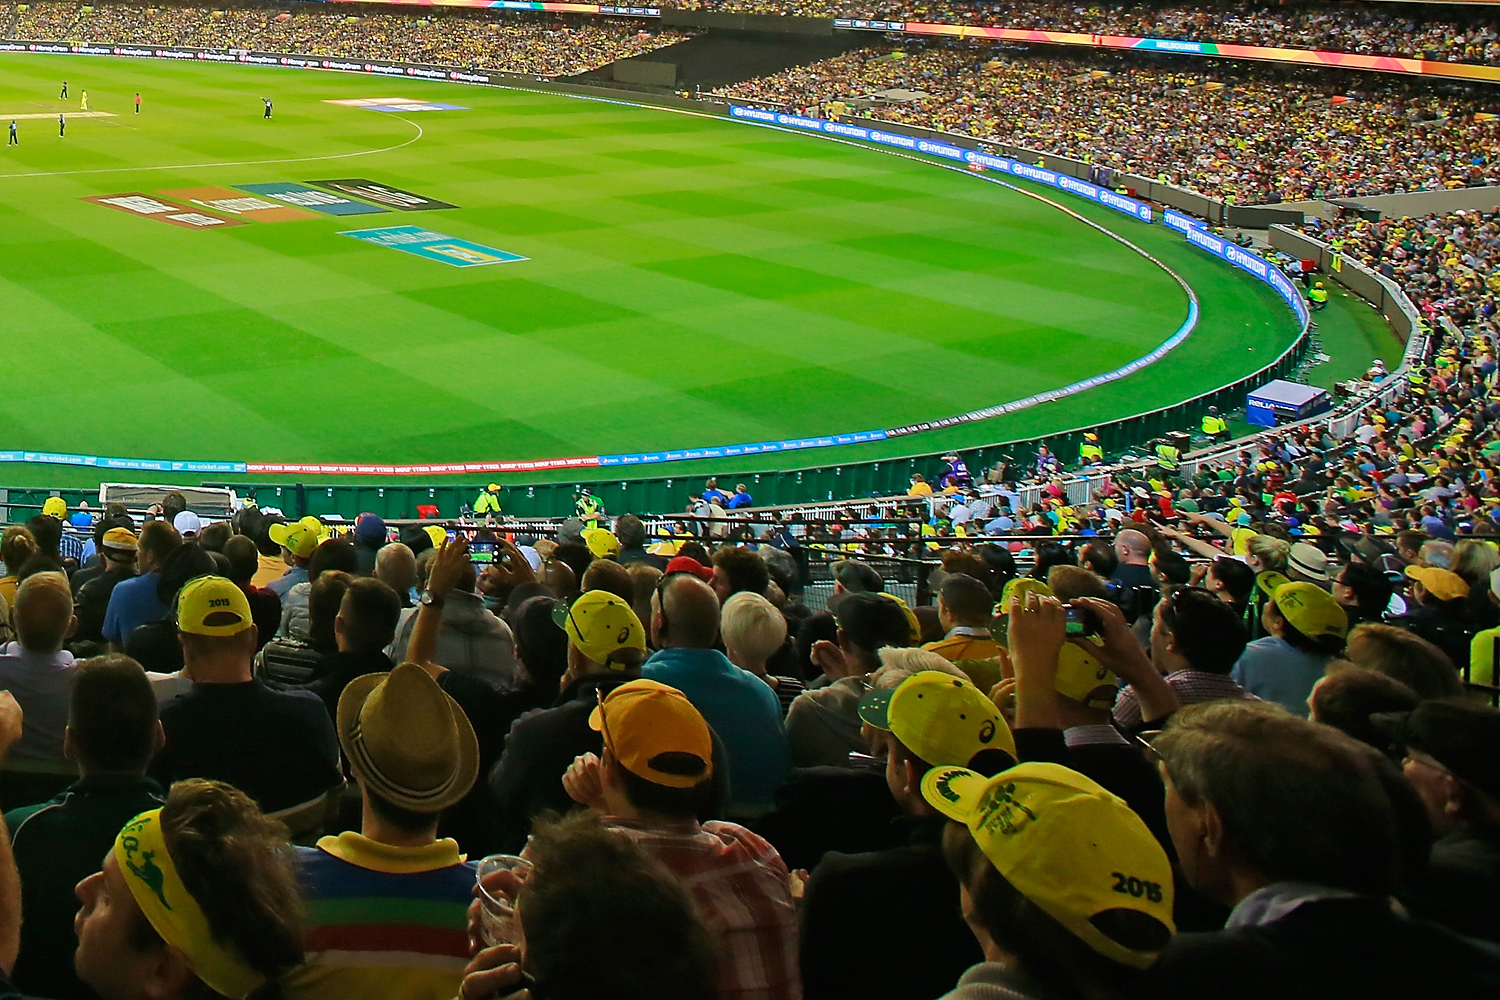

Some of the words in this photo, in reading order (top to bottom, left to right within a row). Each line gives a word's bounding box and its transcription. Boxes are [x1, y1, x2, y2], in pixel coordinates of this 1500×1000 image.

[1156, 41, 1200, 50] MELBOURNE
[120, 48, 151, 56] MoneyGram
[163, 50, 193, 58] MoneyGram
[205, 53, 235, 61] MoneyGram
[246, 55, 276, 63] MoneyGram
[330, 61, 361, 70] MoneyGram
[372, 64, 403, 73] MoneyGram
[414, 67, 445, 78] MoneyGram
[457, 71, 488, 82] MoneyGram
[744, 110, 774, 120] HYUNDAI
[789, 118, 819, 128] HYUNDAI
[835, 125, 866, 137] HYUNDAI
[881, 134, 914, 147] HYUNDAI
[928, 143, 960, 157] HYUNDAI
[976, 153, 1008, 170] HYUNDAI
[1023, 166, 1054, 182] HYUNDAI
[1068, 179, 1095, 197] HYUNDAI
[1108, 194, 1135, 213] HYUNDAI
[1192, 230, 1221, 253] HYUNDAI
[1236, 251, 1265, 276] HYUNDAI
[209, 599, 230, 607] 2015
[1112, 872, 1162, 903] 2015
